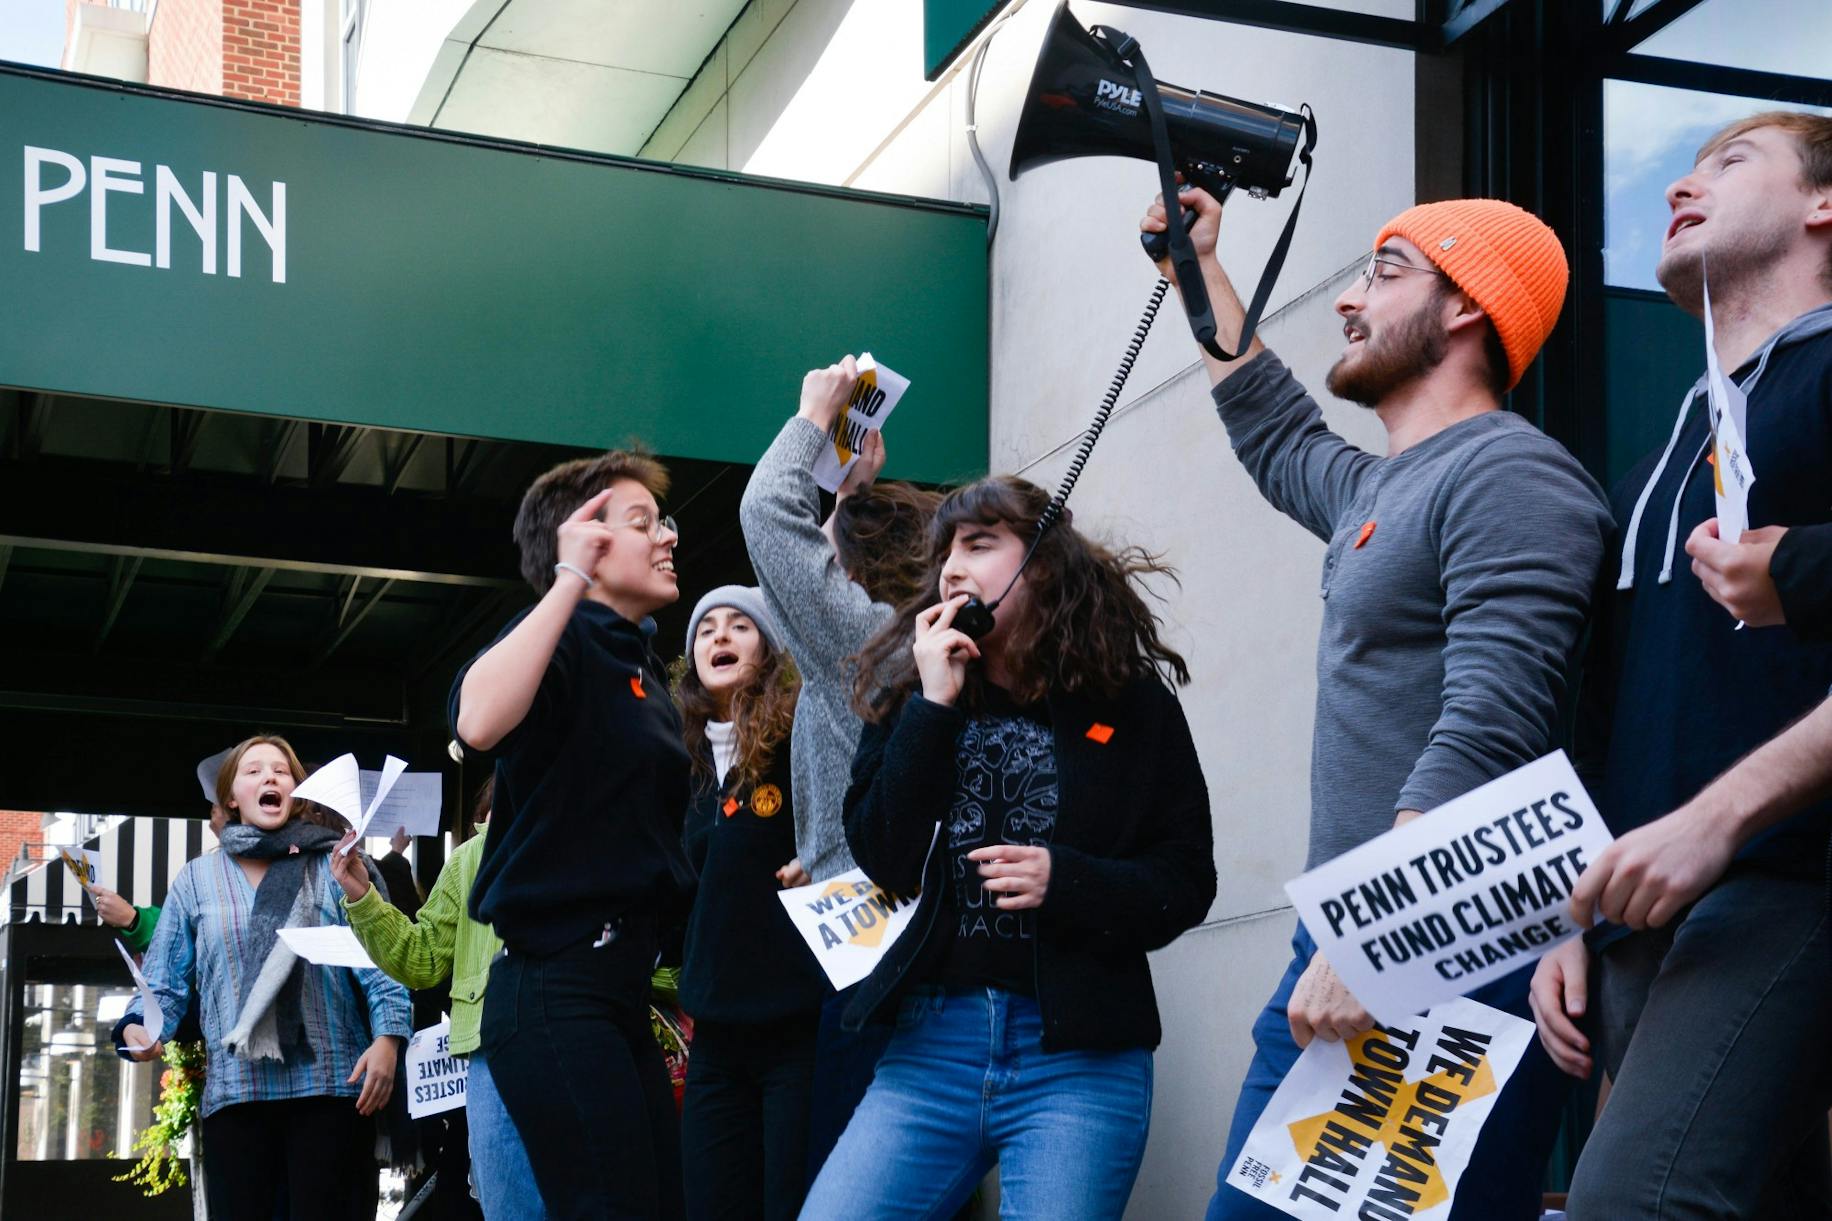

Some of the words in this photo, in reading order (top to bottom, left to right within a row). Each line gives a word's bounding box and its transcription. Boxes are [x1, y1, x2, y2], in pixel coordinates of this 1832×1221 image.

[24, 145, 286, 284] PENN
[1320, 867, 1417, 938] PENN
[1409, 791, 1584, 896] TRUSTEES
[806, 888, 853, 916] WE
[1361, 913, 1456, 973] FUND
[1452, 846, 1588, 936] CLIMATE
[818, 922, 843, 950] A
[1434, 915, 1572, 981] CHANGE
[418, 1057, 469, 1080] LIMATE
[1334, 1021, 1421, 1131] TOWN
[1426, 1025, 1493, 1087] WE
[415, 1077, 468, 1103] USTEES
[1239, 1156, 1255, 1177] PENN
[1247, 1160, 1263, 1180] FREE
[1252, 1164, 1271, 1189] FOSSIL
[1289, 1120, 1374, 1213] HALL
[1358, 1081, 1462, 1221] DEMAND
